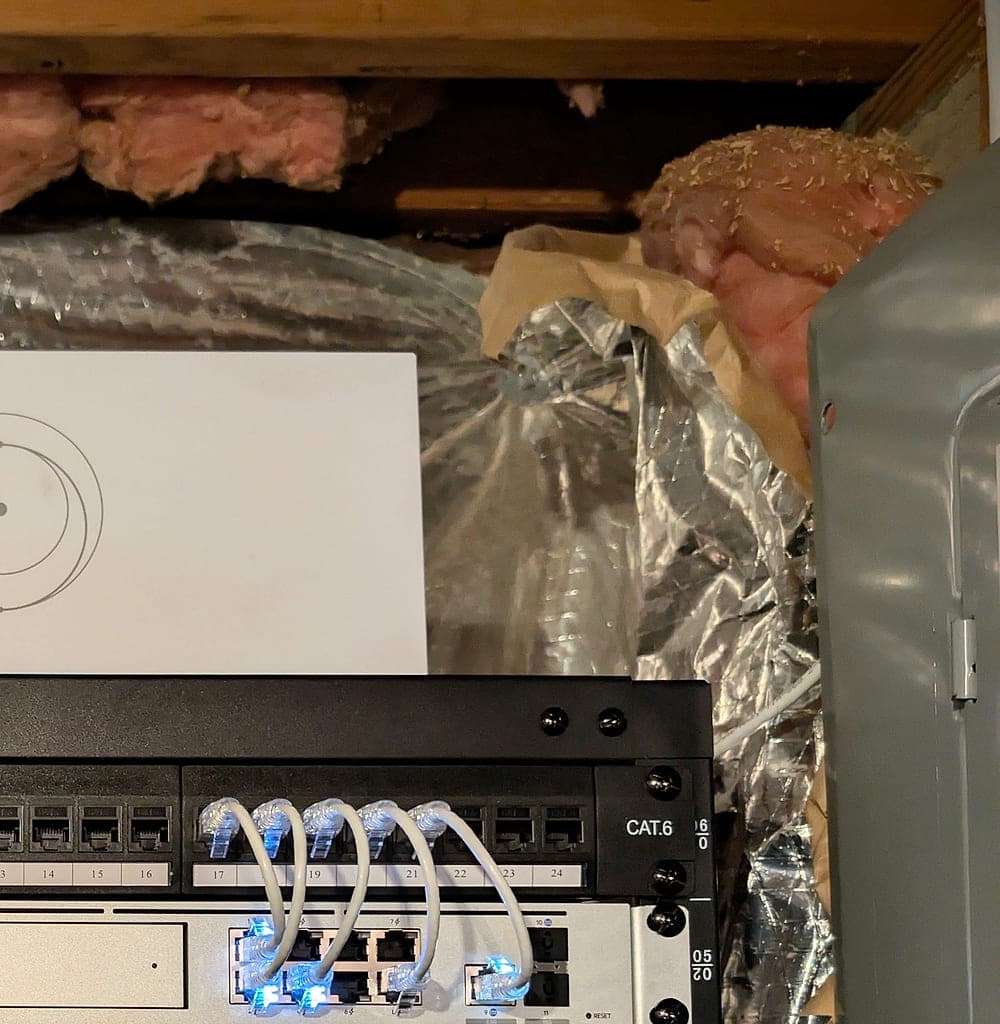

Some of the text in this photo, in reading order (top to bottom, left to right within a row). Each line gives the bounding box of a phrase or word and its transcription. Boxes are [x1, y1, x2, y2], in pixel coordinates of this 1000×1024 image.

[626, 819, 673, 836] CAT.6
[42, 868, 55, 879] 14
[91, 868, 104, 879] 15
[140, 868, 153, 879] 16
[213, 868, 563, 880] 17 19 21 22 23 24
[692, 949, 712, 962] 05
